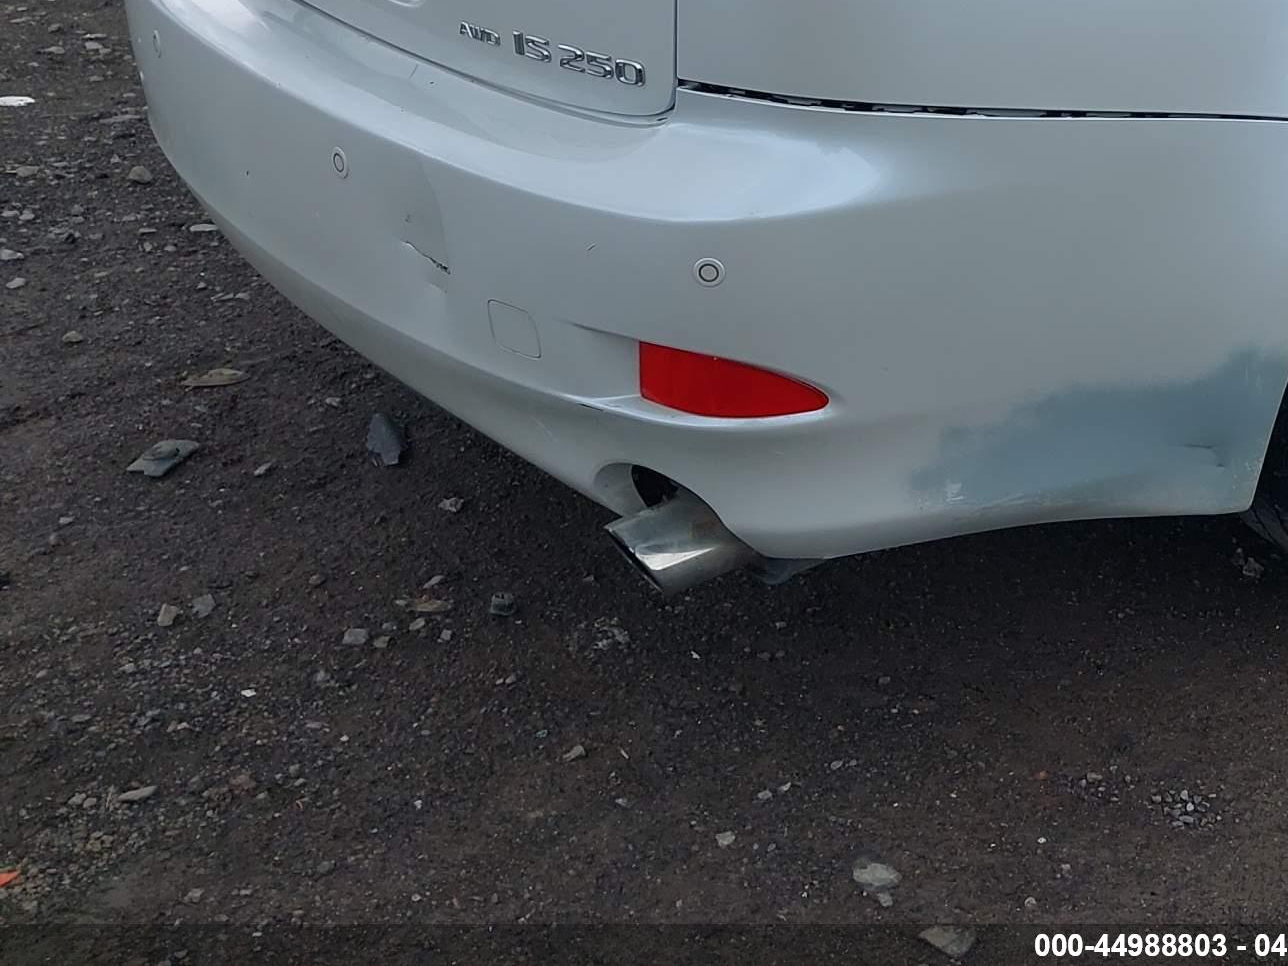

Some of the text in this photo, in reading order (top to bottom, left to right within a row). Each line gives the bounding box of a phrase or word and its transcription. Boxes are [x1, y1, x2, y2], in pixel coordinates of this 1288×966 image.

[459, 21, 646, 87] AWD IS 250
